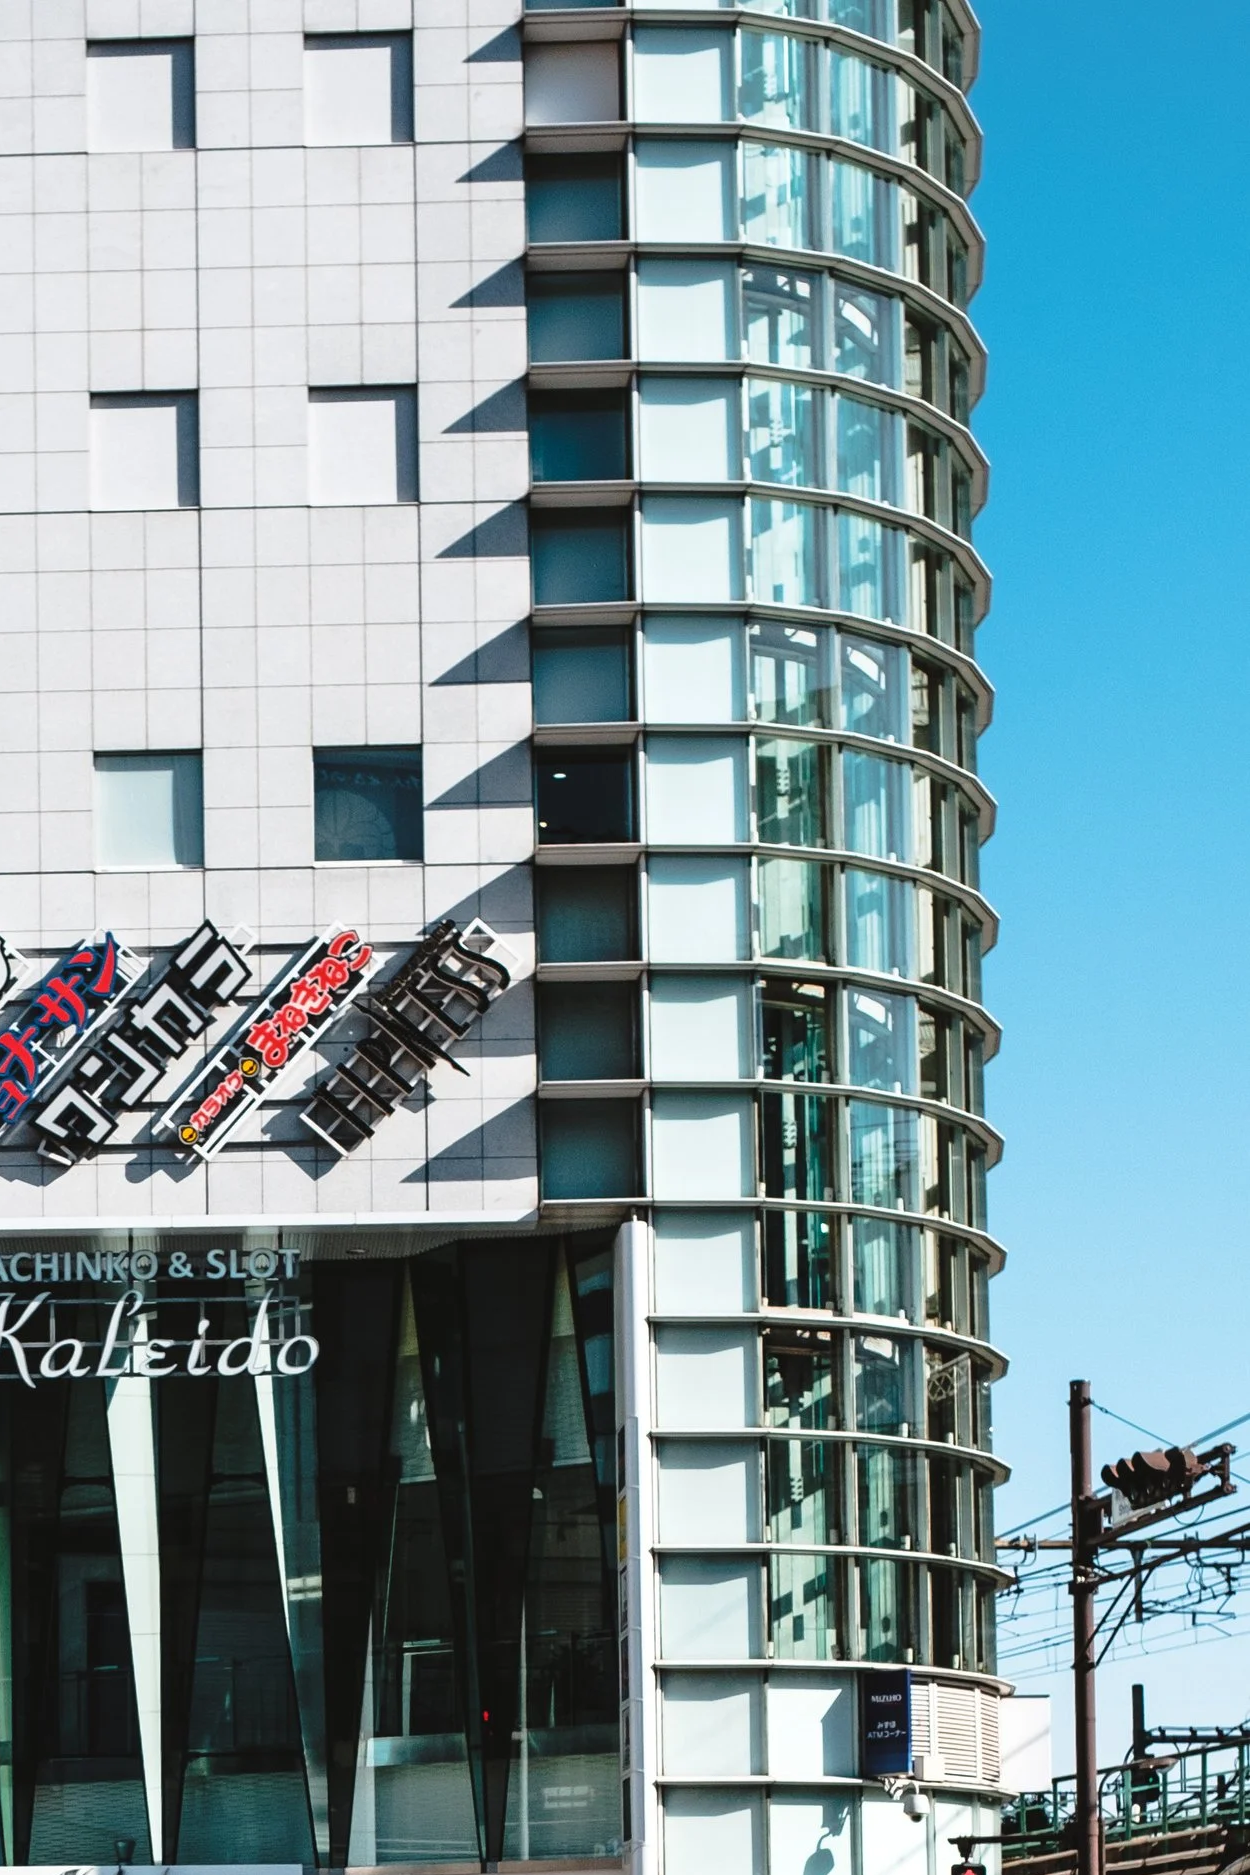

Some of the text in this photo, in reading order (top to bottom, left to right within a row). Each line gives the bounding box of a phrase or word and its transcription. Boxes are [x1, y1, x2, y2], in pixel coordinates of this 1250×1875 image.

[34, 922, 245, 1144] ワンカラ
[248, 930, 372, 1068] まねきねこ
[190, 1070, 244, 1131] カラオケ
[168, 1251, 193, 1277] &
[206, 1248, 302, 1279] SLOT
